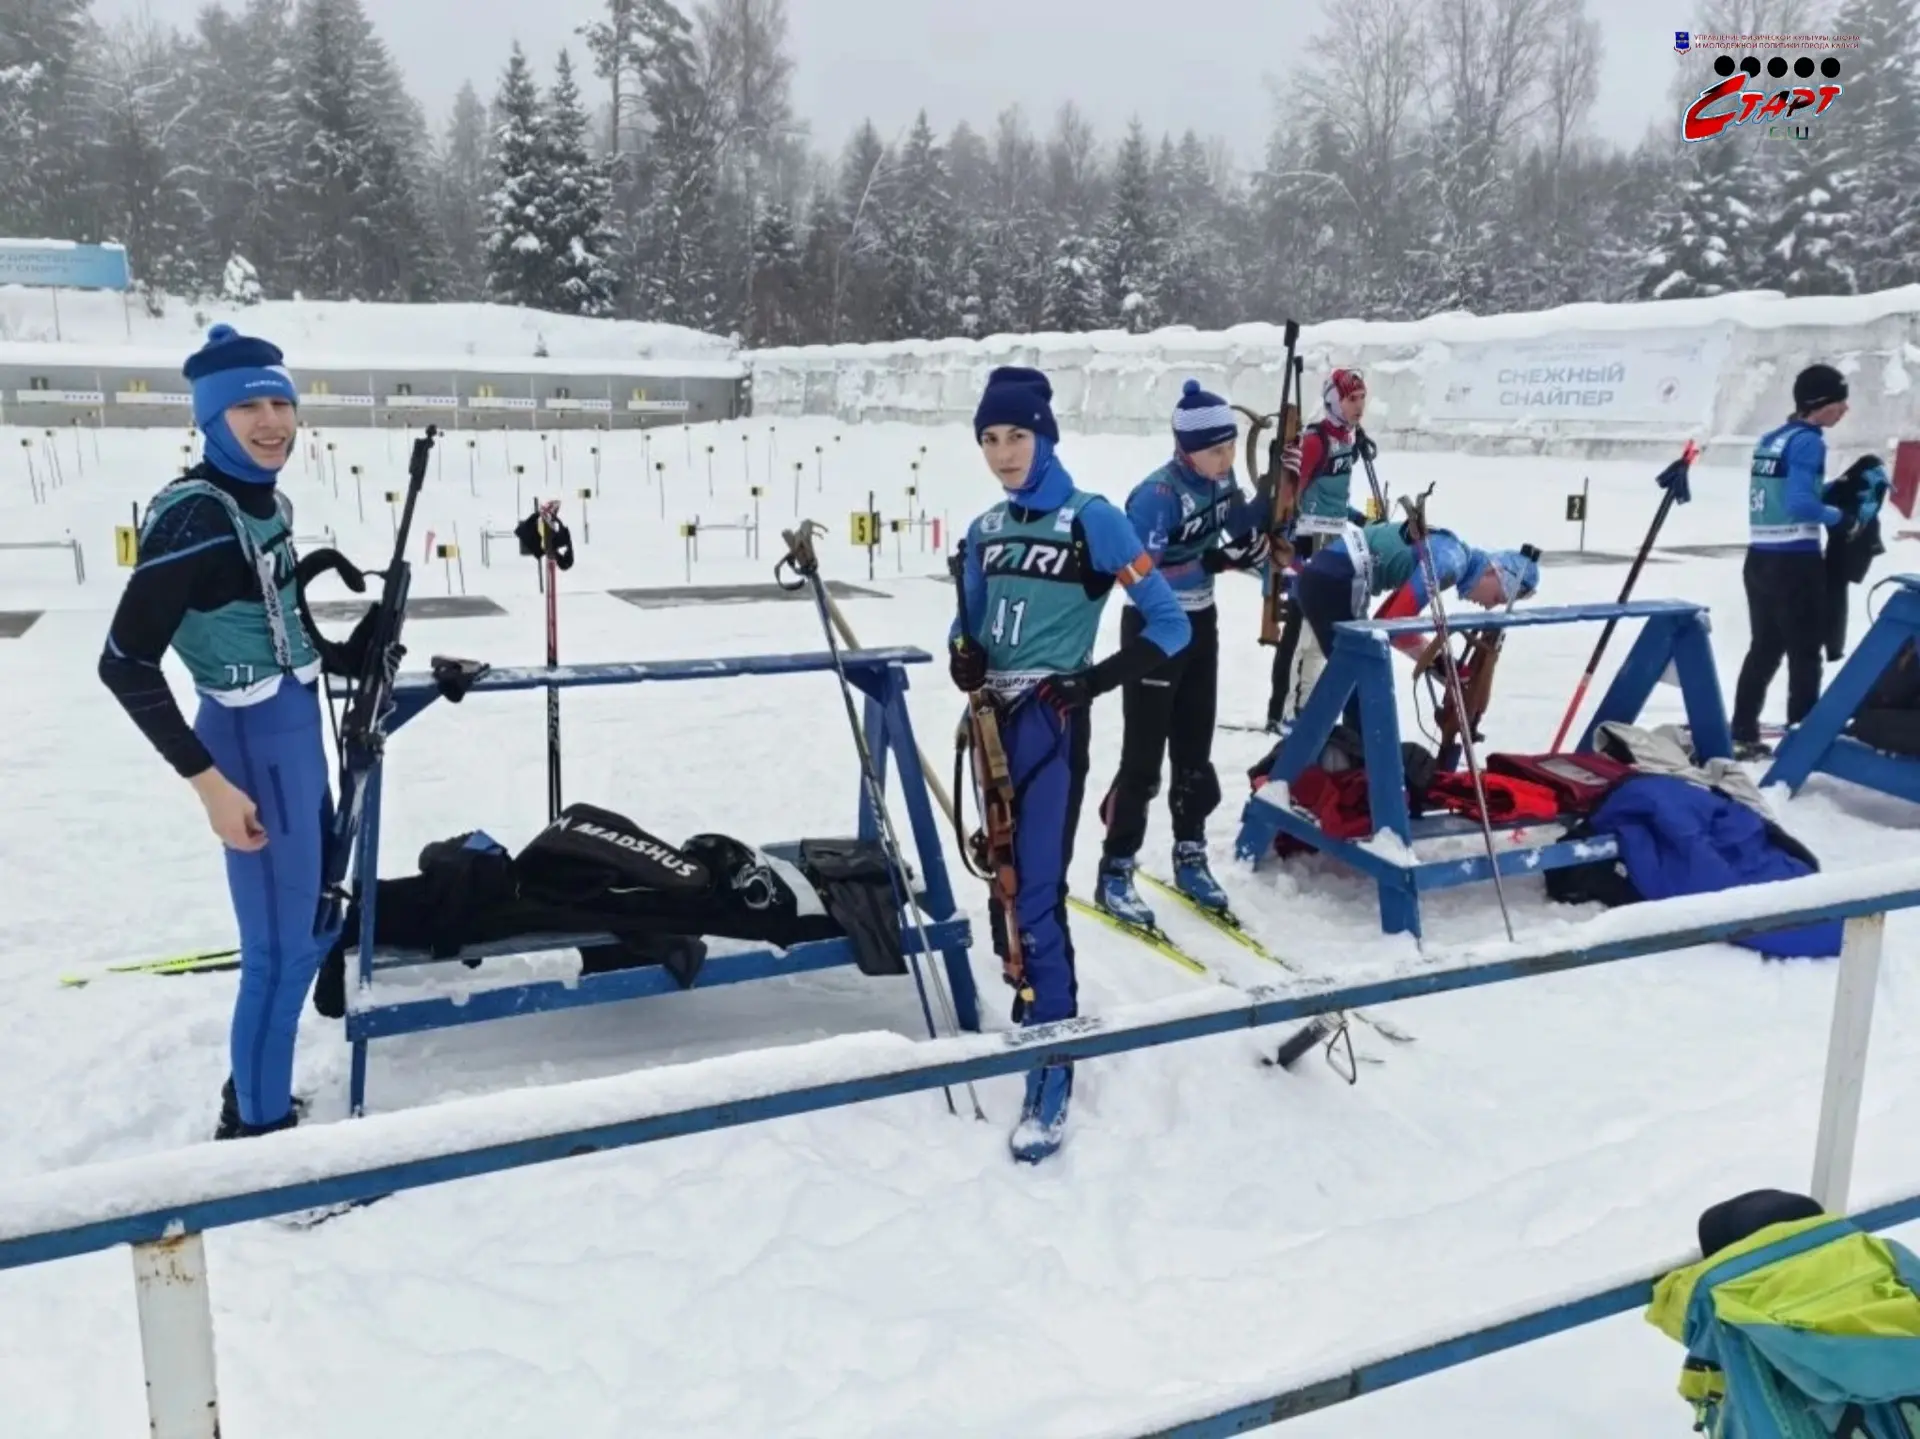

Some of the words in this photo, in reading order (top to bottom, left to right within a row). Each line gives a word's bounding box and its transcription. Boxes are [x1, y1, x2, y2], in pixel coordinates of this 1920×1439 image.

[1497, 361, 1626, 384] СНЕЖНЫЙ
[1499, 386, 1615, 406] СНАЙПЕР
[857, 515, 866, 542] 5
[982, 541, 1069, 576] PARI
[990, 597, 1026, 646] 41
[572, 822, 699, 877] MADSHUS
